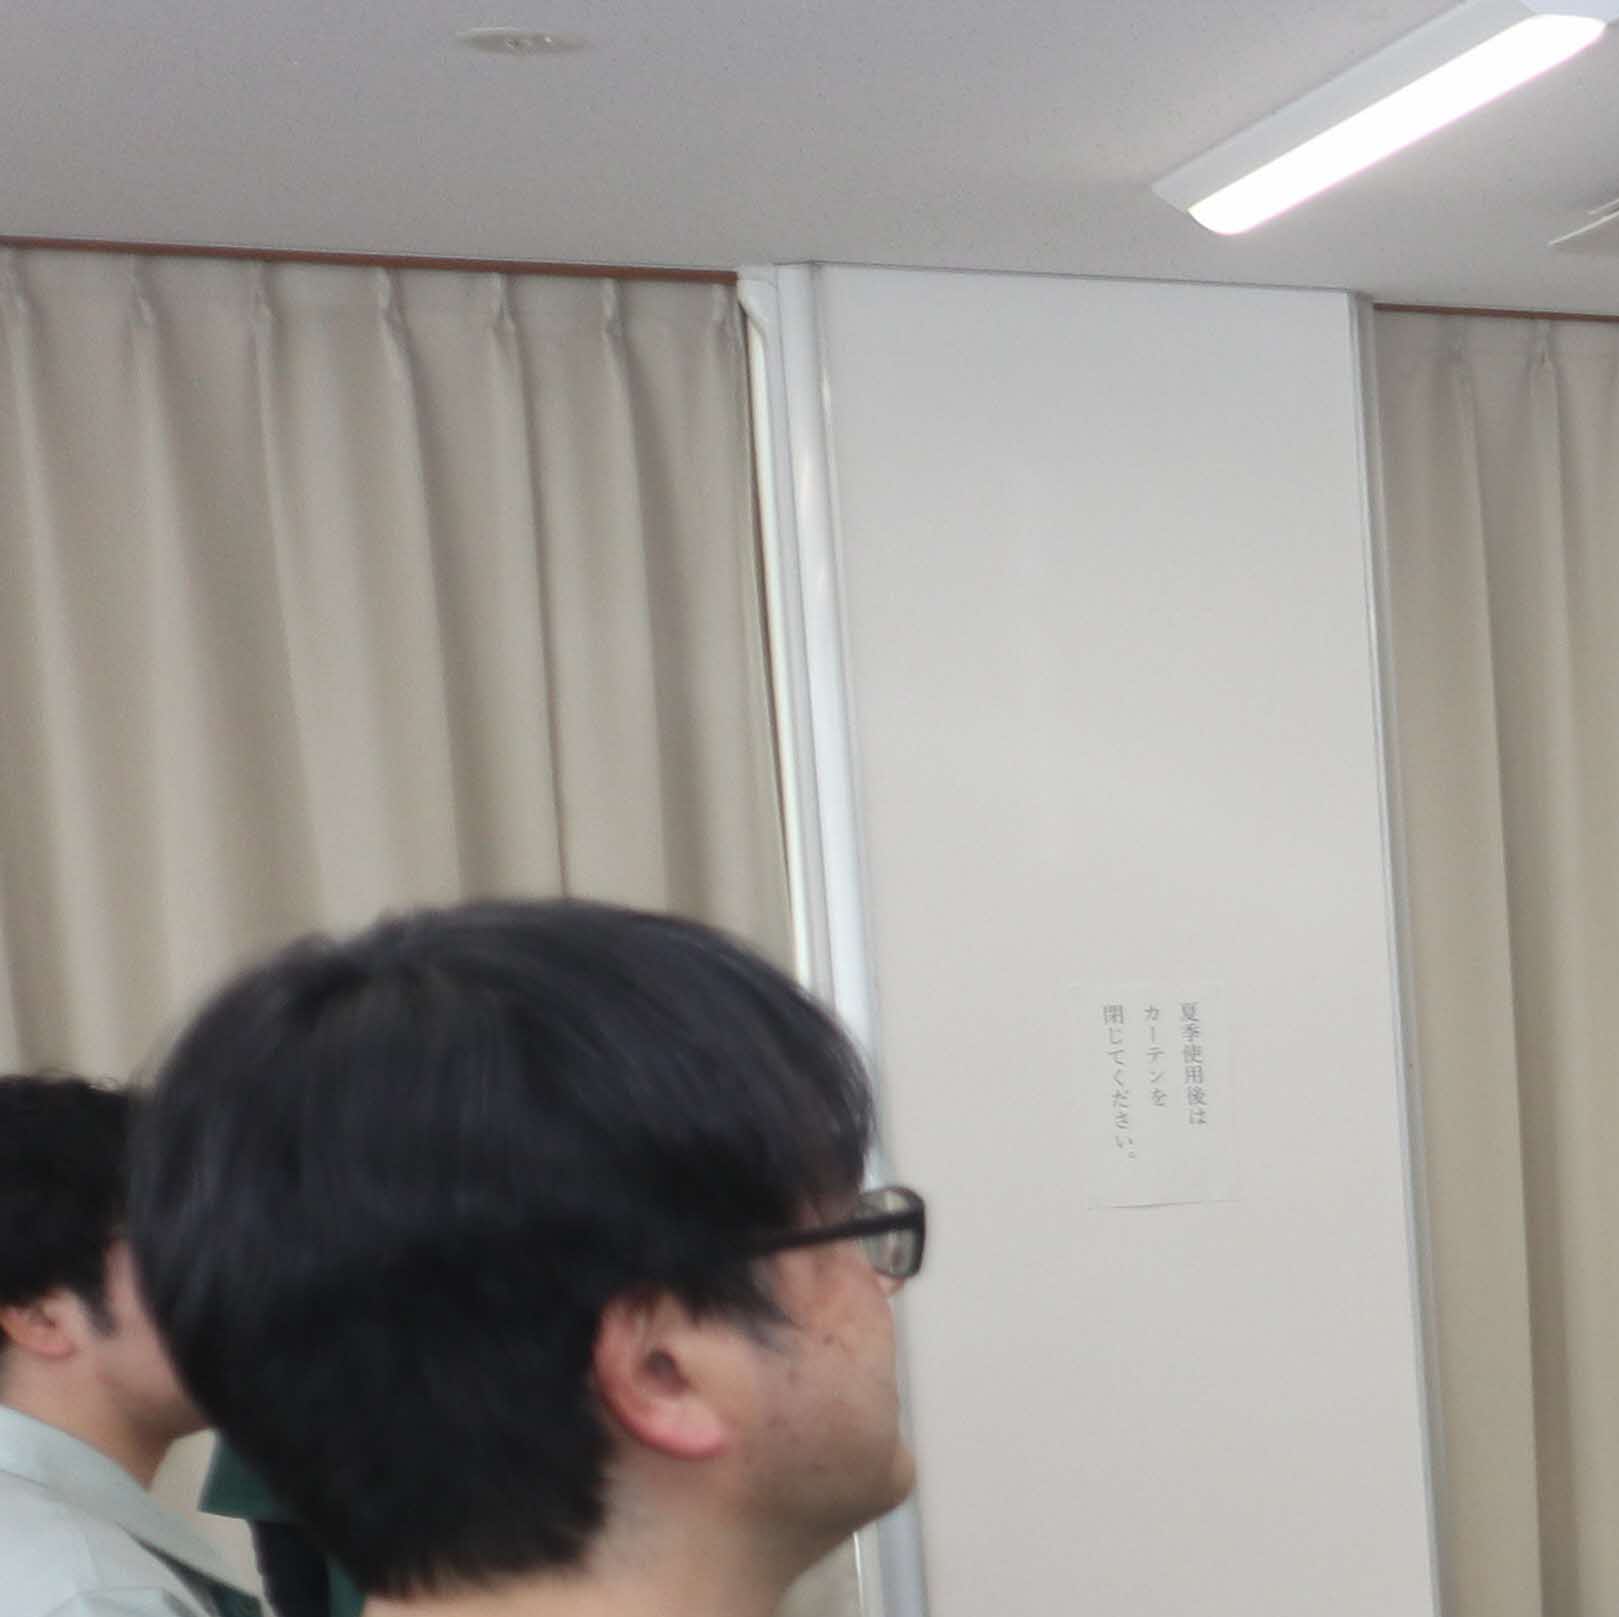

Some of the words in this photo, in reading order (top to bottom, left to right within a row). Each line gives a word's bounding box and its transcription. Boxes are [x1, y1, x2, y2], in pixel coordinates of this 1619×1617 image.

[1101, 1004, 1136, 1159] 閉じてください。
[1143, 1004, 1168, 1107] カーテンを
